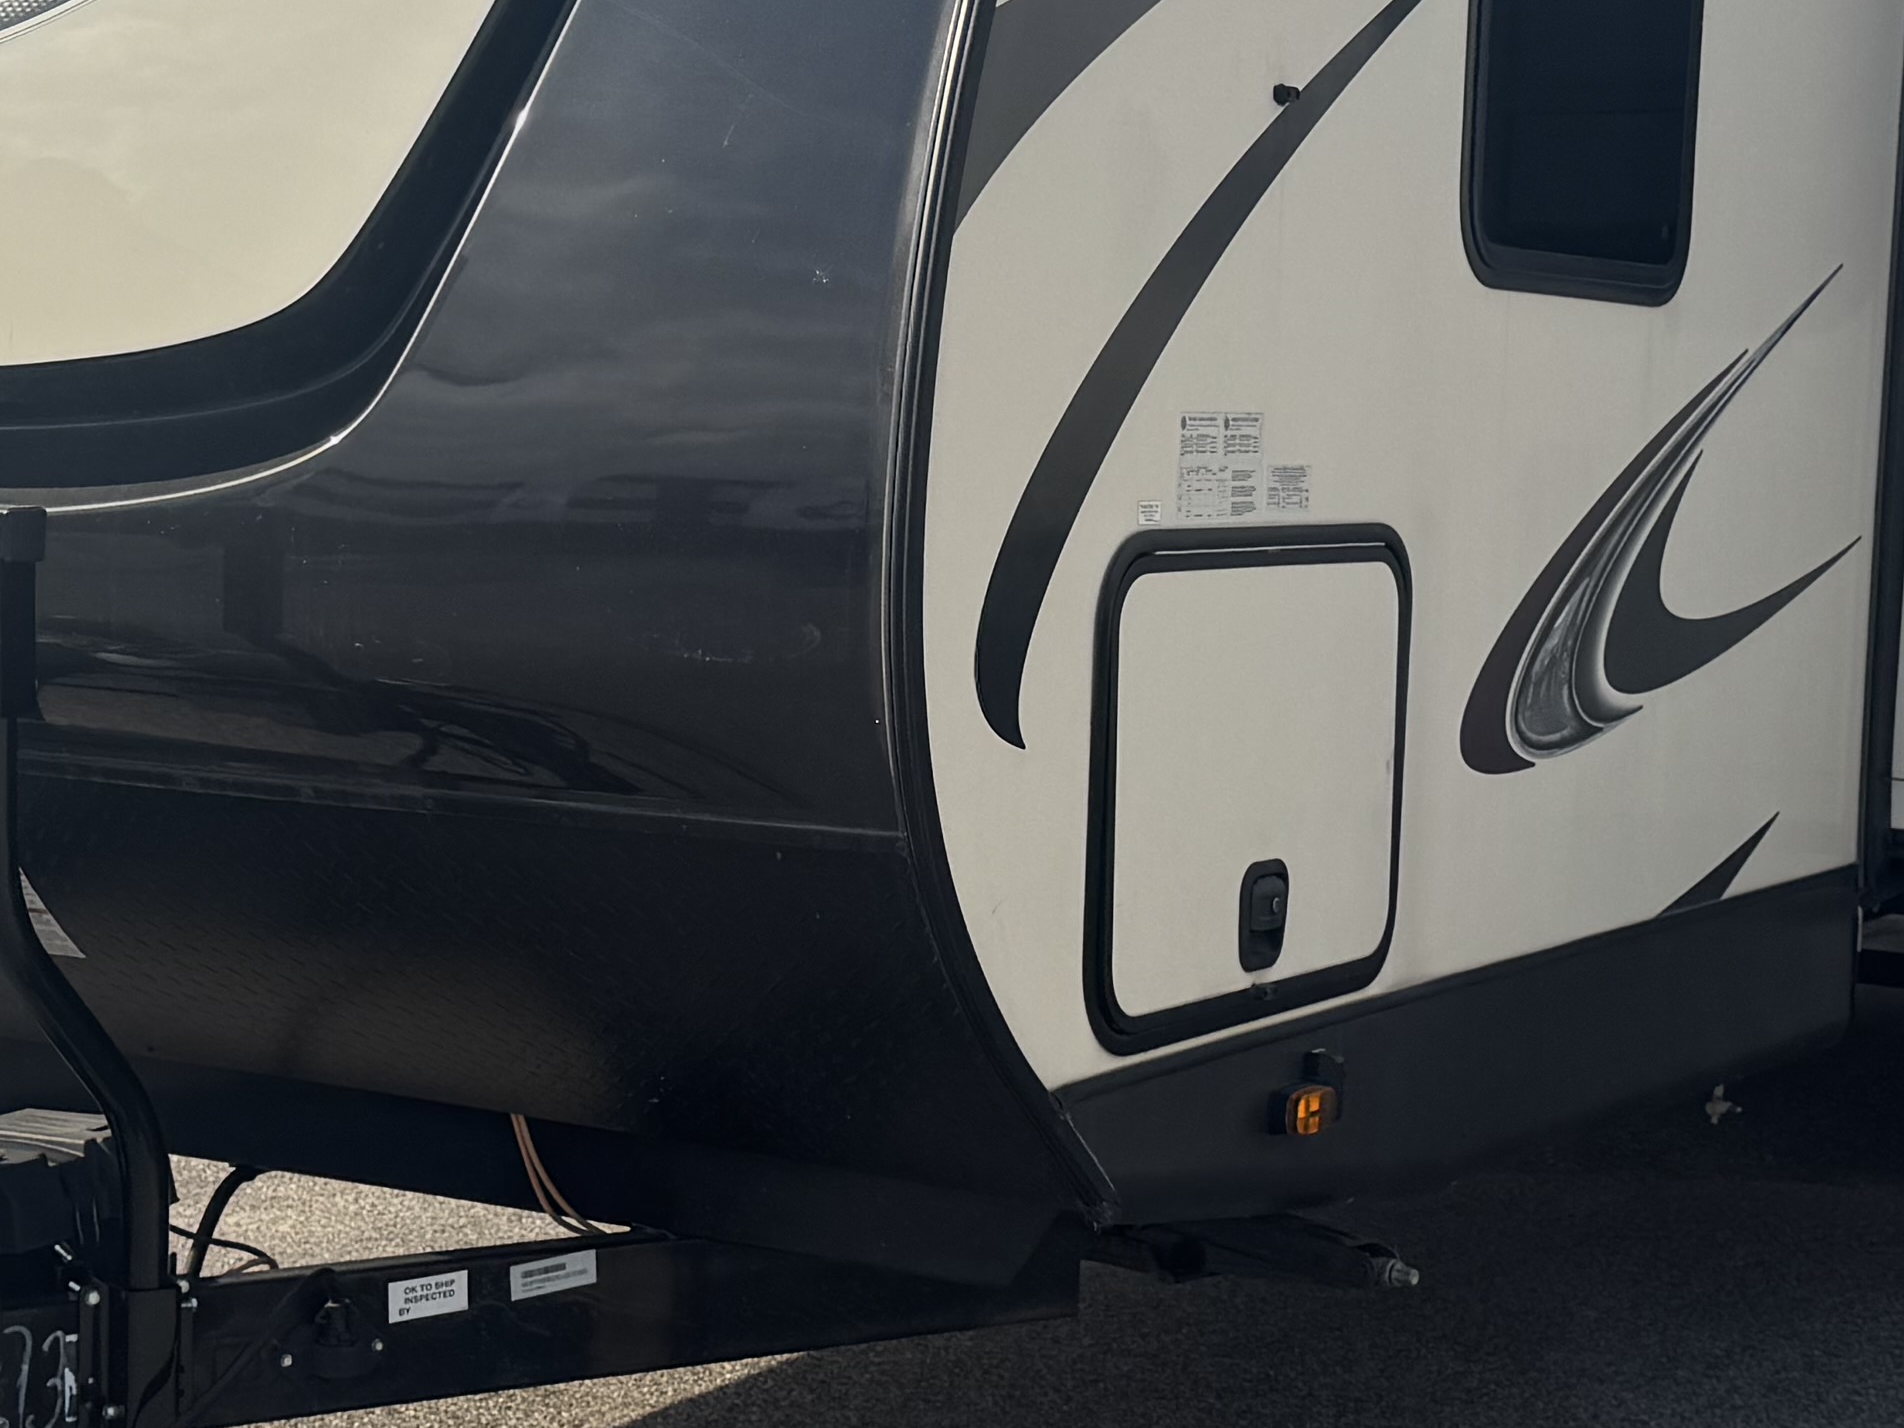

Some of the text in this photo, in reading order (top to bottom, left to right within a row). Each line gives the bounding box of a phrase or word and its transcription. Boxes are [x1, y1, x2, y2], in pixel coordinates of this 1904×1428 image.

[403, 1278, 456, 1296] OK TO SHIP
[404, 1288, 455, 1305] INSPECTED
[398, 1306, 411, 1317] BY
